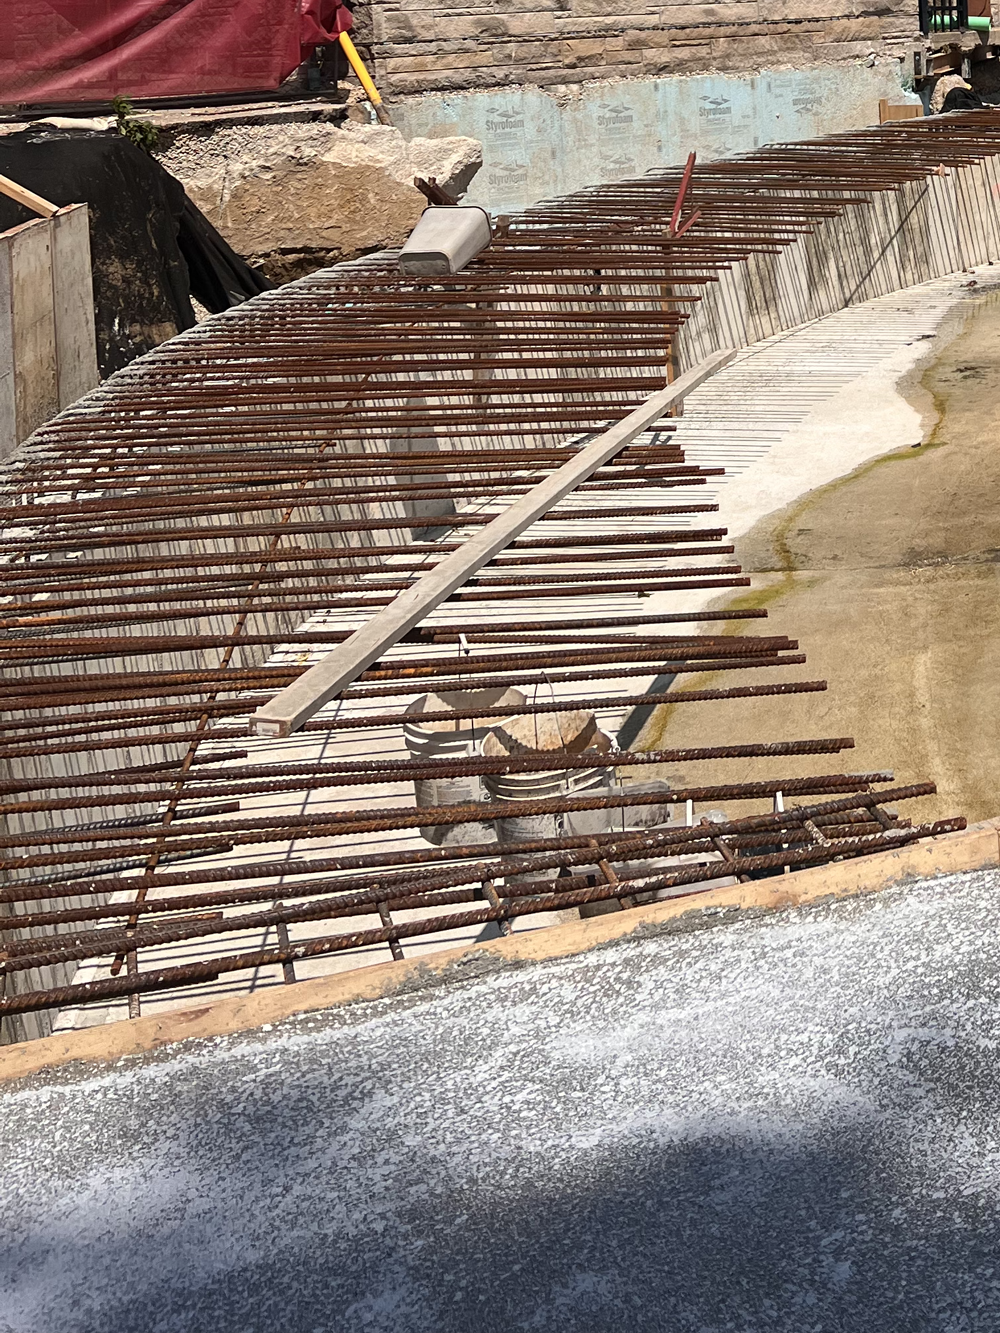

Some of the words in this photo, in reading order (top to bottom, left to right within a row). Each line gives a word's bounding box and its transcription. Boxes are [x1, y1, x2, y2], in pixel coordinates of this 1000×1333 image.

[699, 106, 732, 118] Styrofoam
[485, 119, 525, 132] Styrofoam
[597, 115, 634, 127] Styrofoam
[488, 173, 528, 186] Styrofoam
